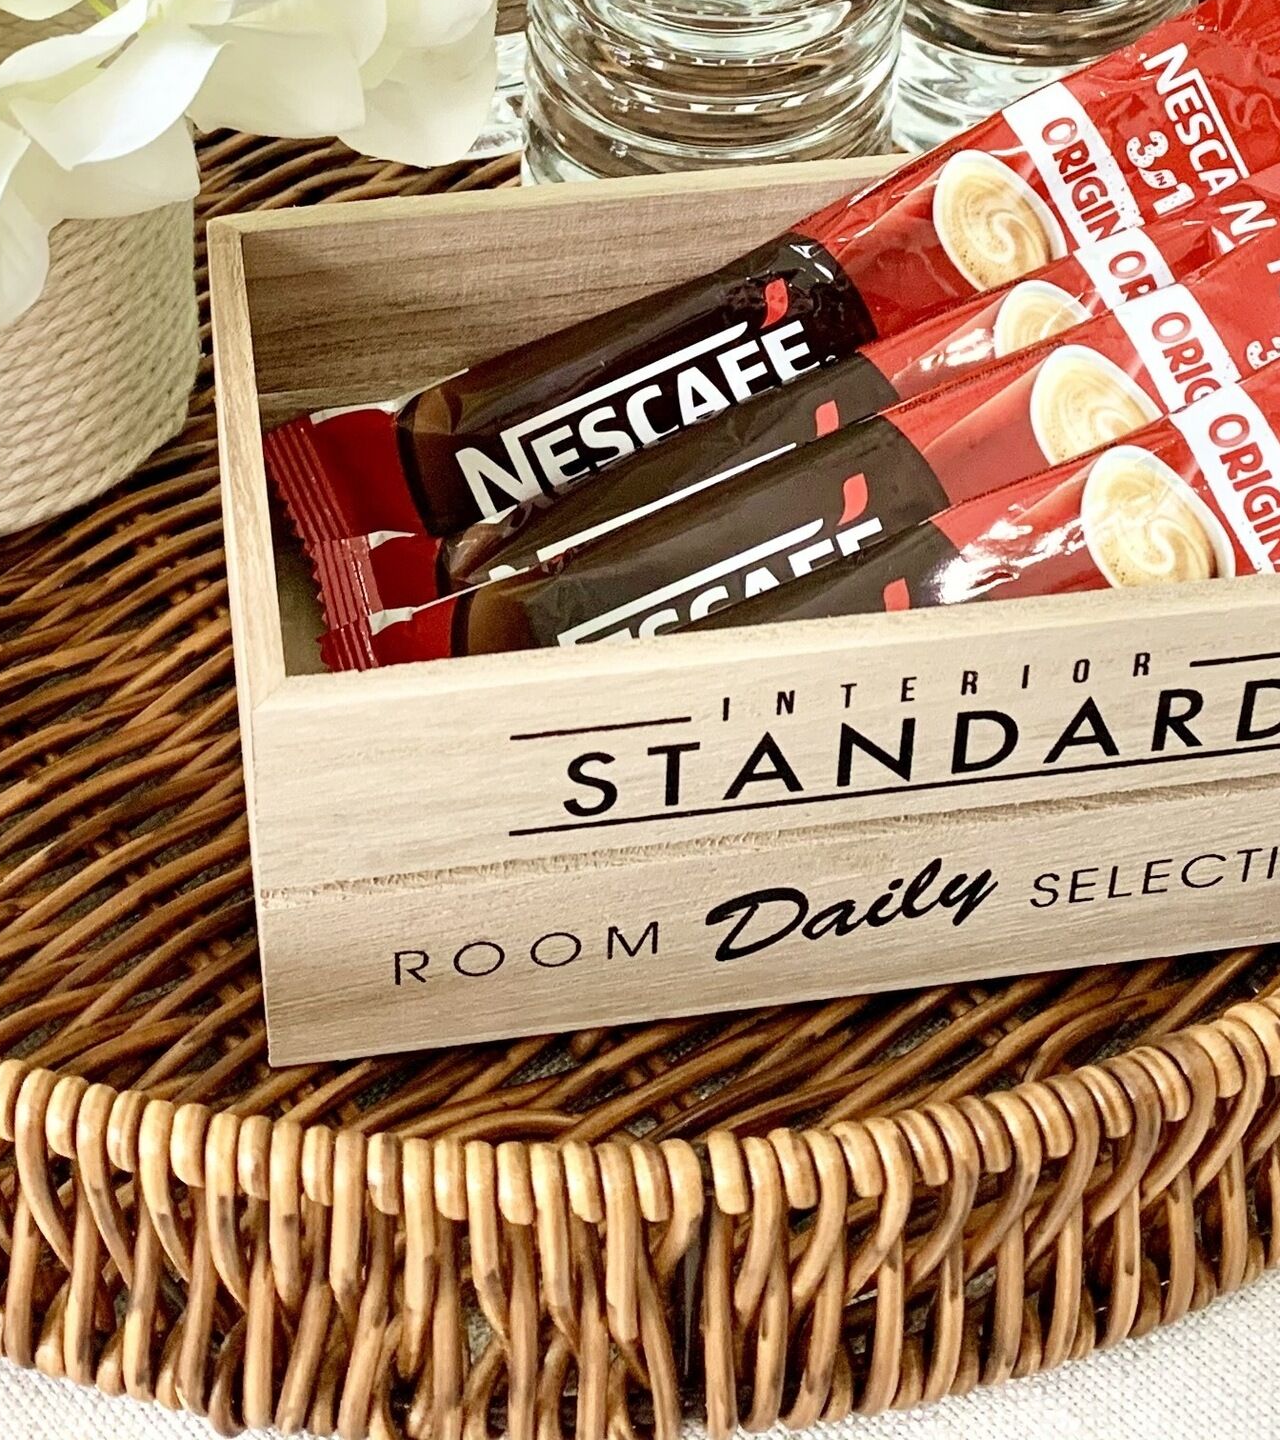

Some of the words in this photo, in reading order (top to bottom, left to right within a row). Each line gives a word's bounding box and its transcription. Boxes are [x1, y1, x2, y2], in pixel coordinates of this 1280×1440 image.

[722, 651, 1152, 722] INTERIOR
[393, 921, 660, 986] ROOM
[705, 857, 999, 963] Daily
